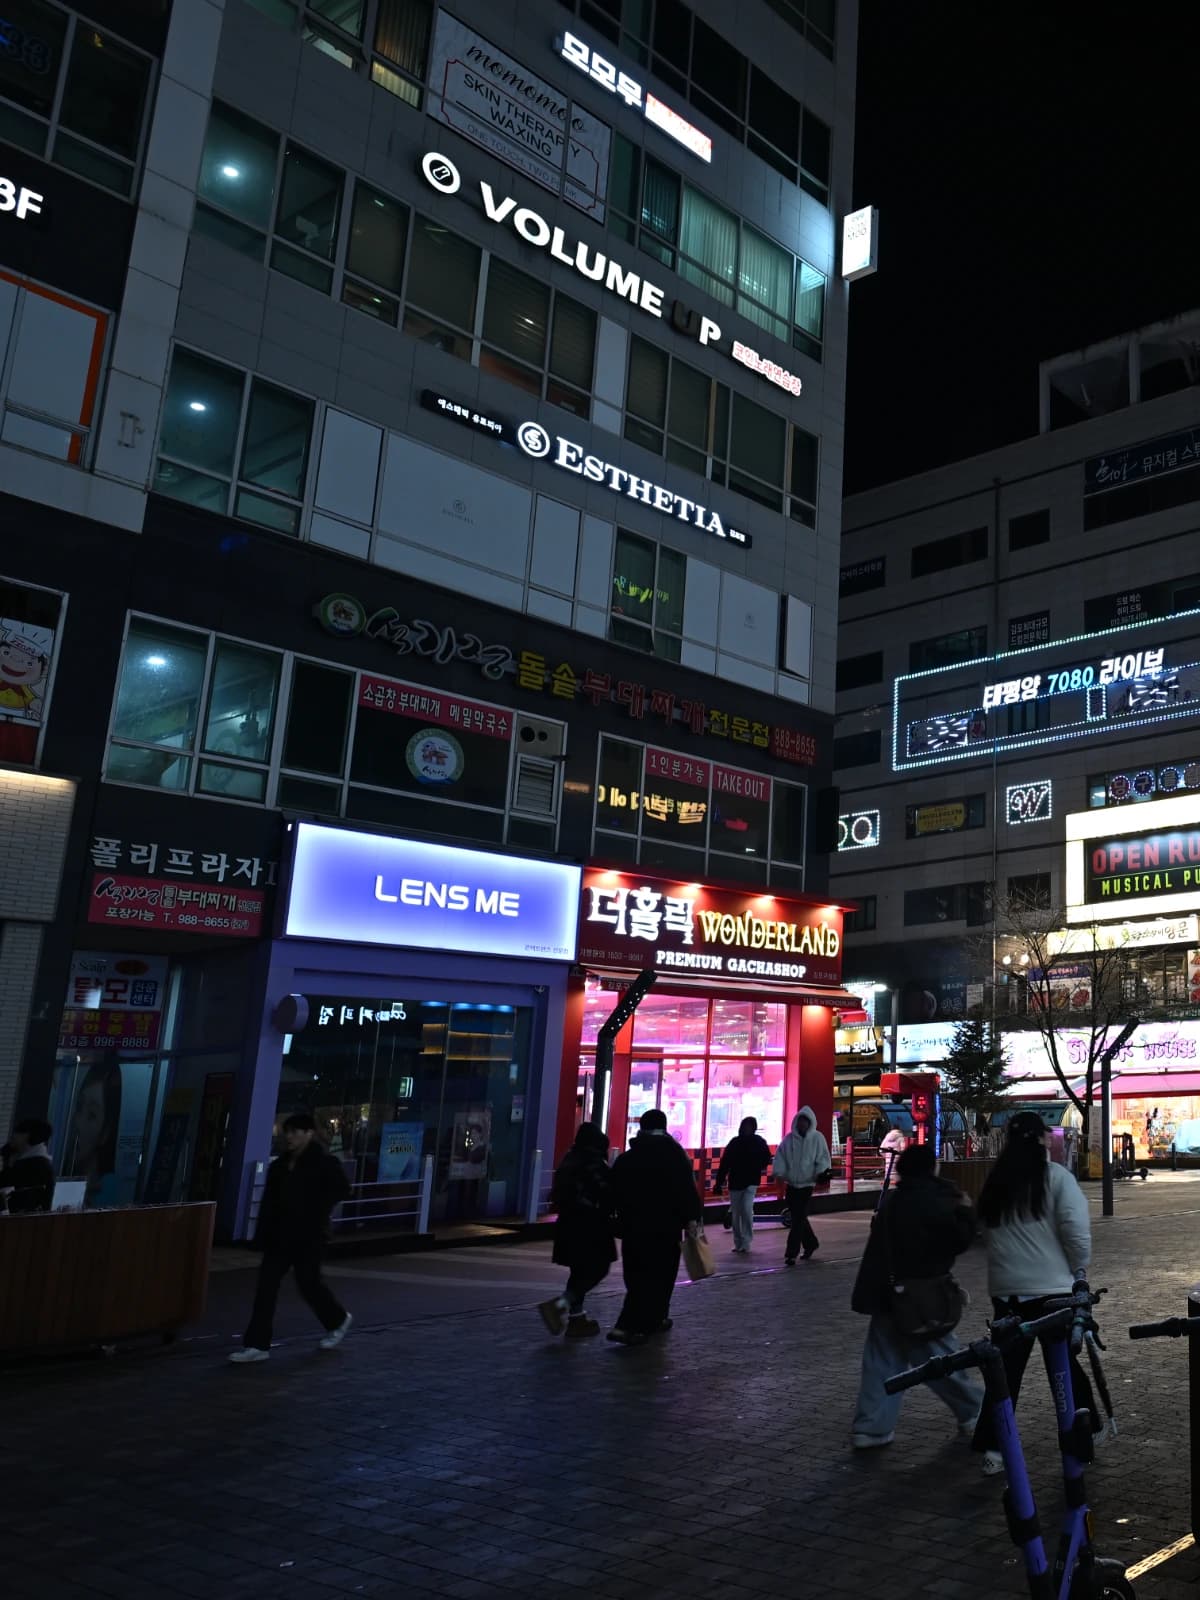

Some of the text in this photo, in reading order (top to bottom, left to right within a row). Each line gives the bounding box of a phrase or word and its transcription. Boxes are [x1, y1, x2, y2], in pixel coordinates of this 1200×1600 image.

[463, 73, 581, 158] SKIN THERAPY
[490, 107, 552, 156] WAXING
[480, 181, 721, 345] VOLUME UP
[732, 340, 802, 397] 코인노래연습장
[1142, 448, 1178, 472] 뮤지컬
[554, 437, 727, 538] ESTHETIA
[517, 650, 577, 700] 돌솥
[582, 667, 706, 736] 부대찌개
[708, 708, 770, 749] 전문점
[983, 648, 1165, 713] 태평양 7080 라이브
[363, 683, 508, 735] 소곱창 부대찌개 메밀막국수
[650, 755, 766, 799] 1인분가능 TAKE OUT
[90, 837, 265, 887] 폴리프라자
[1092, 842, 1161, 875] OPEN
[177, 887, 237, 912] 부대찌개
[375, 875, 520, 917] LENS ME
[1102, 872, 1173, 895] MUSICAL
[106, 906, 155, 922] 포장가능
[178, 914, 230, 928] 988-8655
[586, 886, 840, 958] 더홀릭 WONDERLAND
[656, 950, 722, 970] PREMIUM
[727, 958, 807, 979] GACHASHOP
[1067, 1036, 1134, 1064] SNK
[1055, 1370, 1067, 1414] beam
